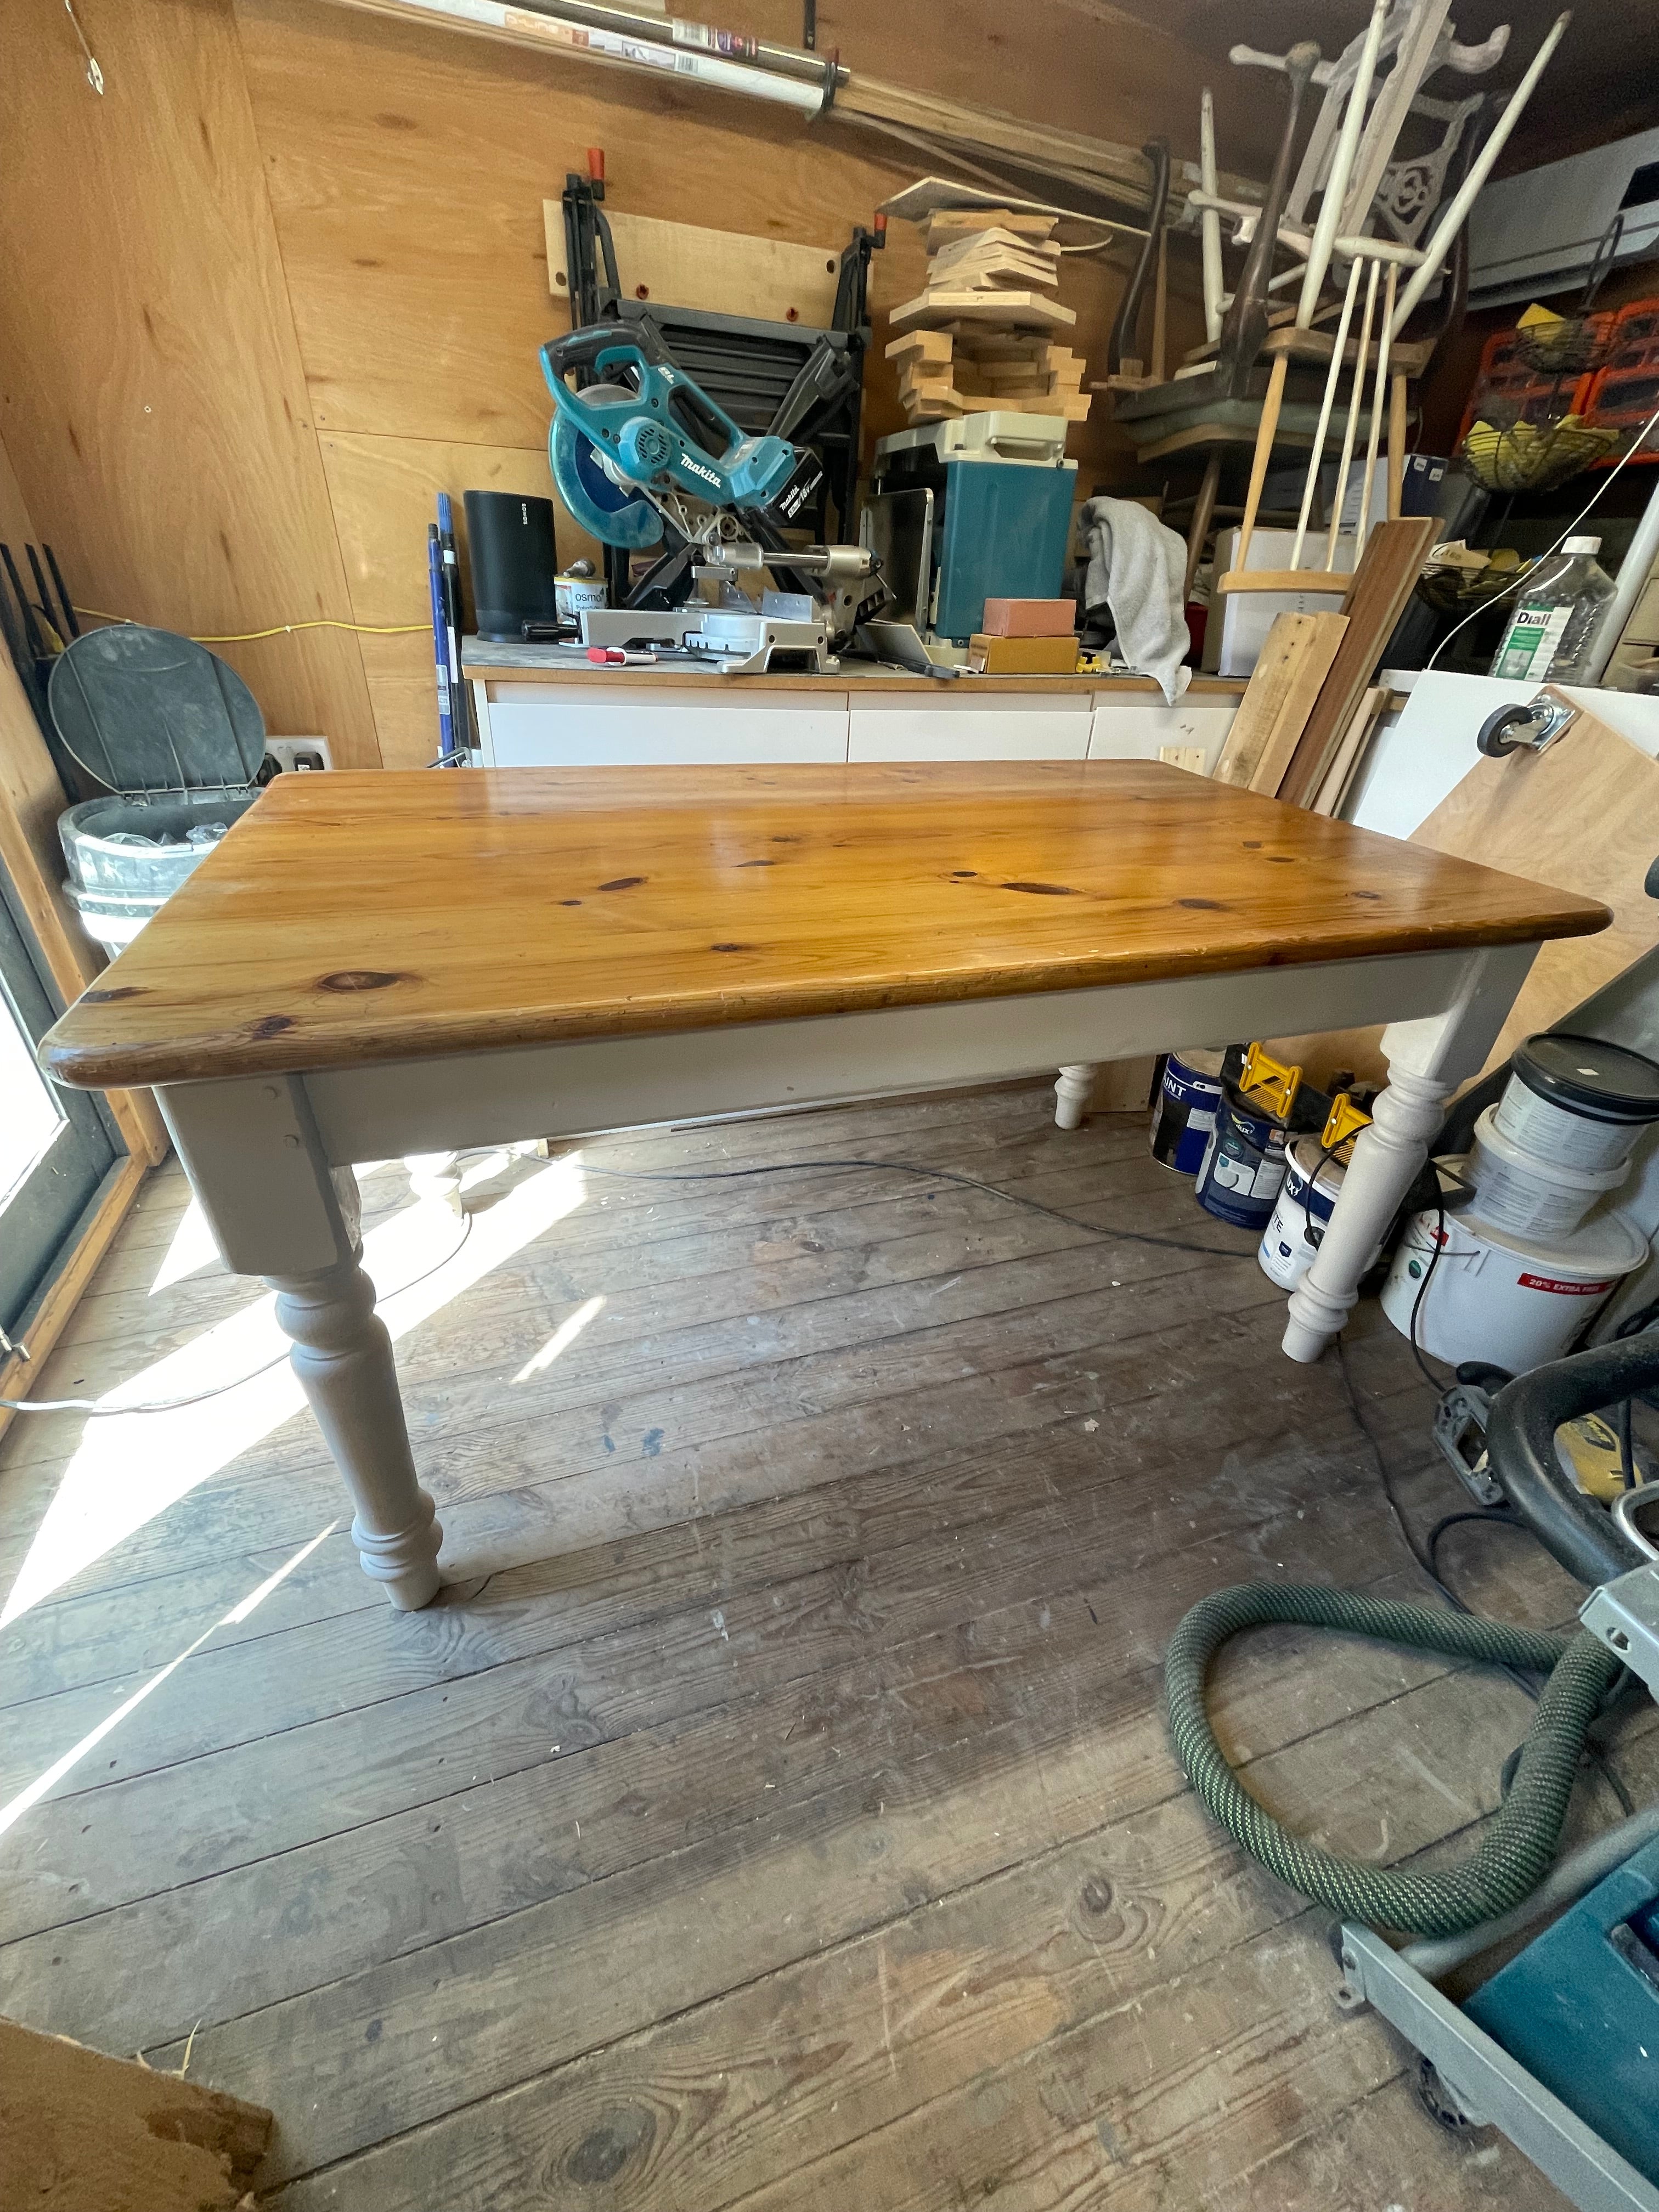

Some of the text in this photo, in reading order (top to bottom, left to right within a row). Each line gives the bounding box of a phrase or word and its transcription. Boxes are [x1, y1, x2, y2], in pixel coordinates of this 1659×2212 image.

[575, 593, 602, 602] osmo
[1516, 612, 1552, 626] Diall
[1529, 1278, 1551, 1289] 20%
[1553, 1283, 1581, 1292] EXTRA
